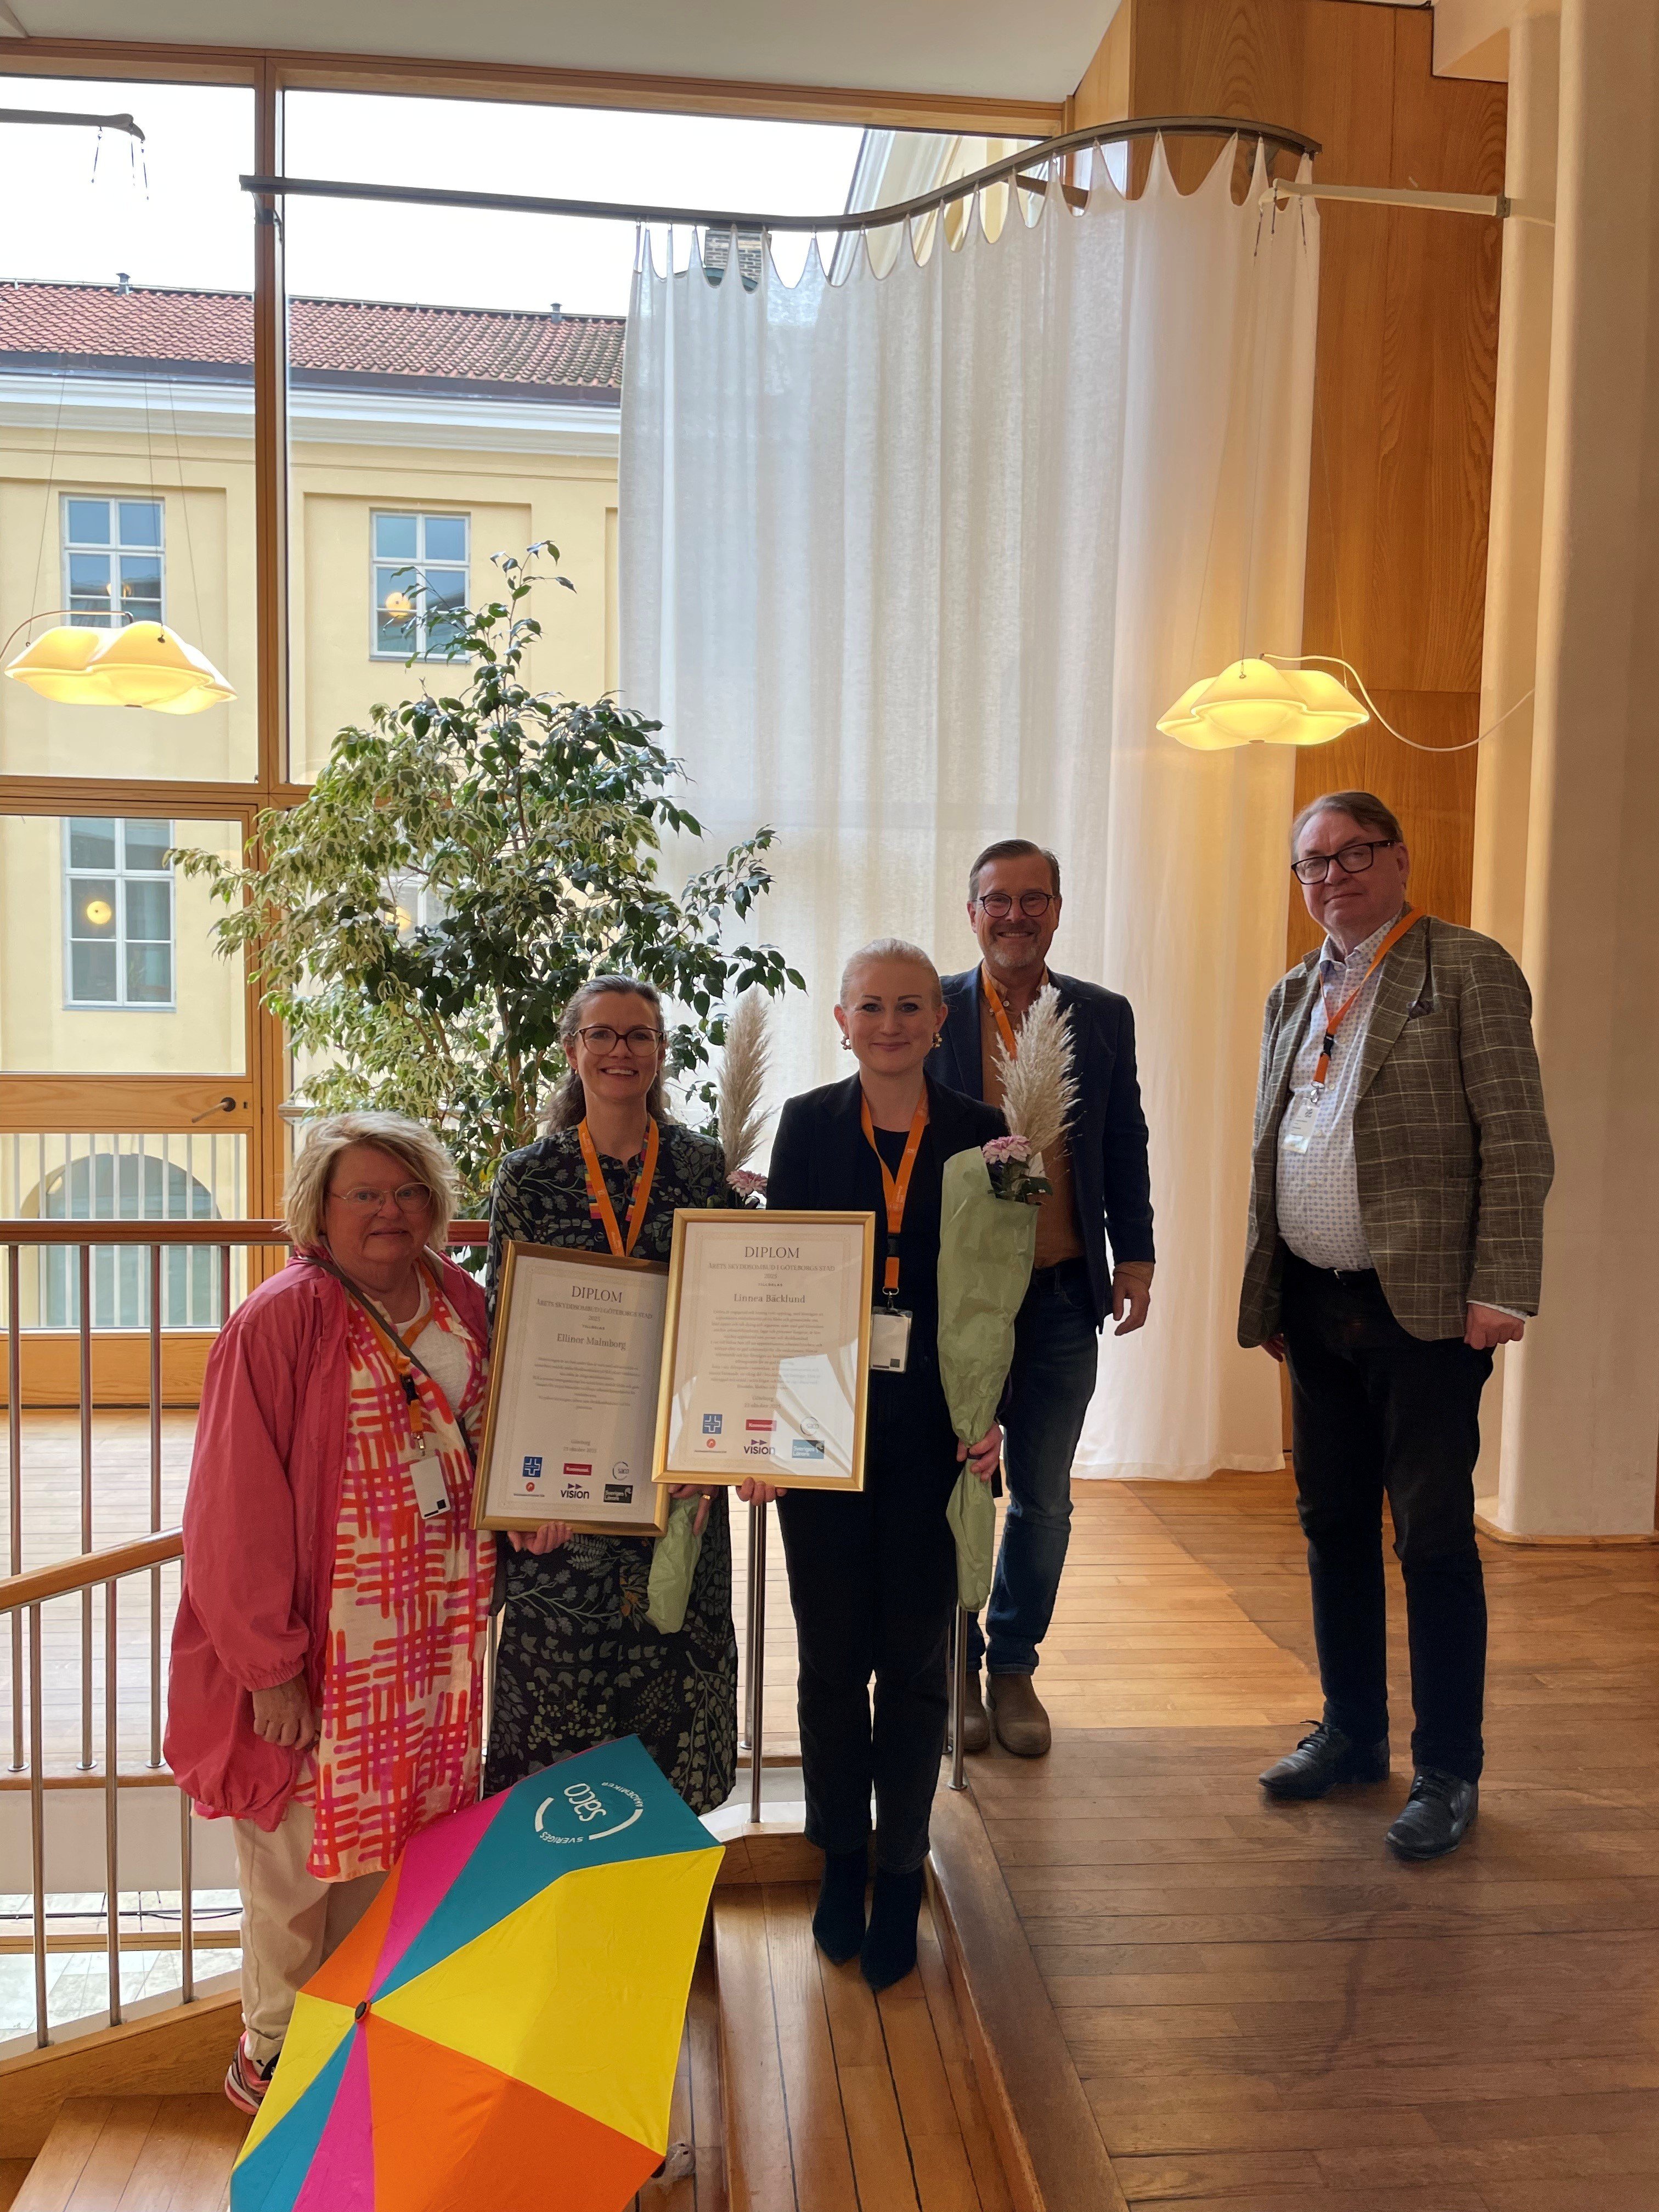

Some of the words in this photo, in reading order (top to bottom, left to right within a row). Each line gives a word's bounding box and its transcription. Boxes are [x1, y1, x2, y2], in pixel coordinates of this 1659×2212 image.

[744, 1246, 799, 1259] DIPLOM
[572, 1285, 623, 1303] DIPLOM
[734, 1294, 763, 1302] Linnea
[766, 1294, 805, 1303] Bäcklund
[557, 1333, 584, 1345] Ellinor
[586, 1336, 626, 1351] Malmborg
[743, 1446, 776, 1455] vision
[561, 1489, 590, 1499] vision
[564, 1783, 606, 1822] saco
[540, 1831, 584, 1844] SVERIGES
